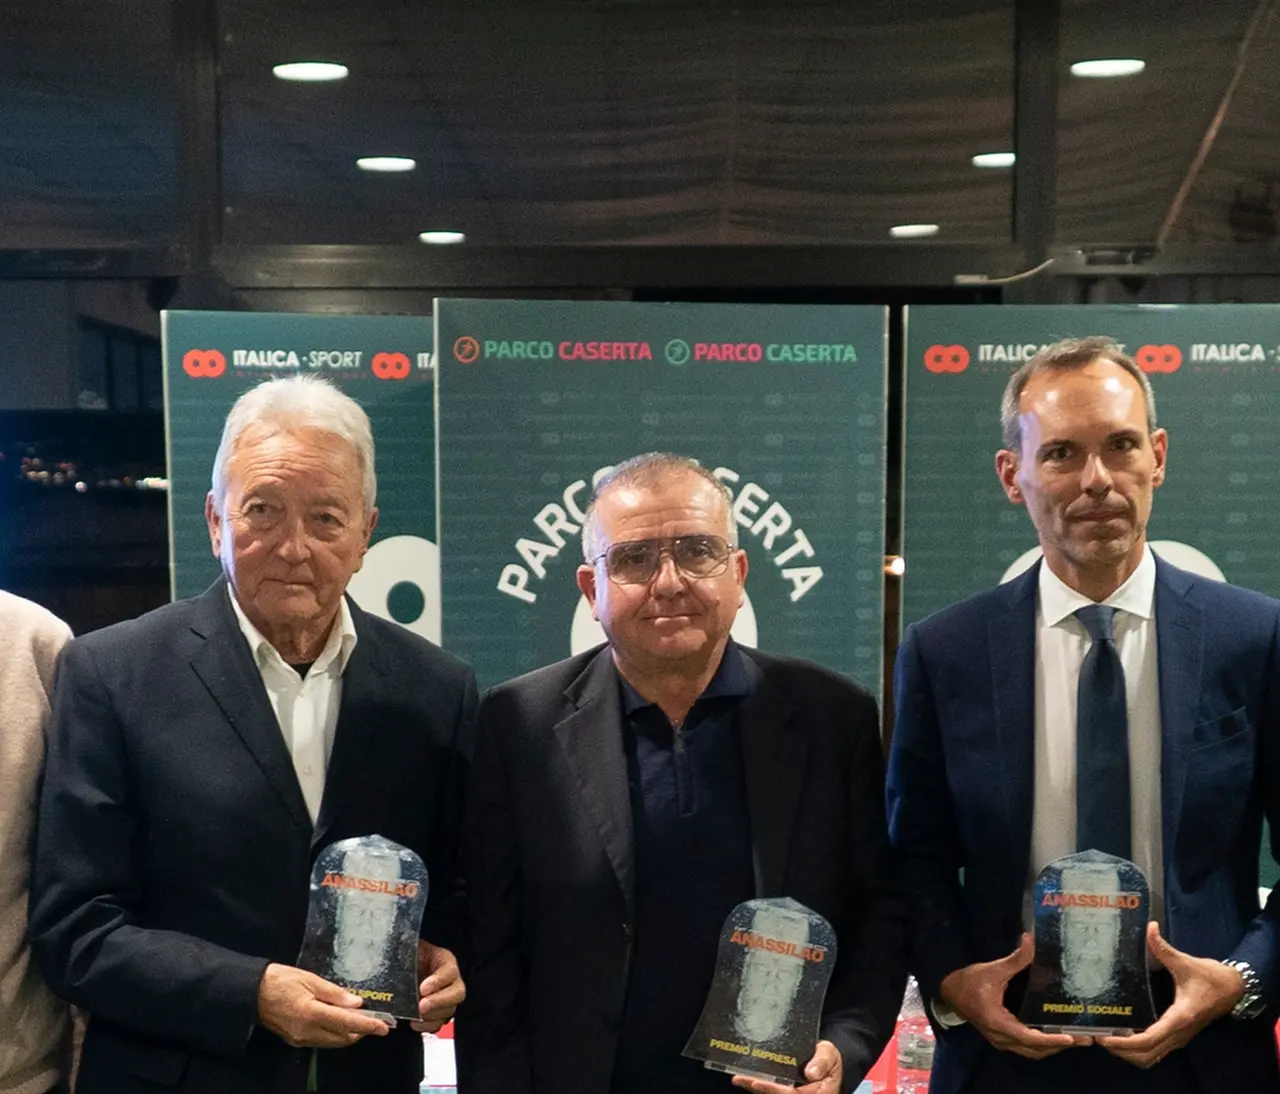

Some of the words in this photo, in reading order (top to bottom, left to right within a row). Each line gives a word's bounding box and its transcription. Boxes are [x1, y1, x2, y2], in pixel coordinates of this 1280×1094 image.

[233, 349, 300, 368] ITALICA
[484, 340, 554, 360] PARCO
[558, 340, 653, 361] CASERTA
[693, 342, 762, 363] PARCO
[766, 343, 858, 364] CASERTA
[1190, 343, 1266, 361] ITALICA
[321, 872, 419, 899] ANASSILAO
[1041, 893, 1140, 909] ANASSILAO
[729, 929, 825, 963] ANASSILAO
[1042, 1003, 1085, 1014] PREMIO
[1087, 1003, 1133, 1016] SOCIALE
[709, 1038, 751, 1056] PREMIO
[751, 1048, 797, 1066] IMPRESA
